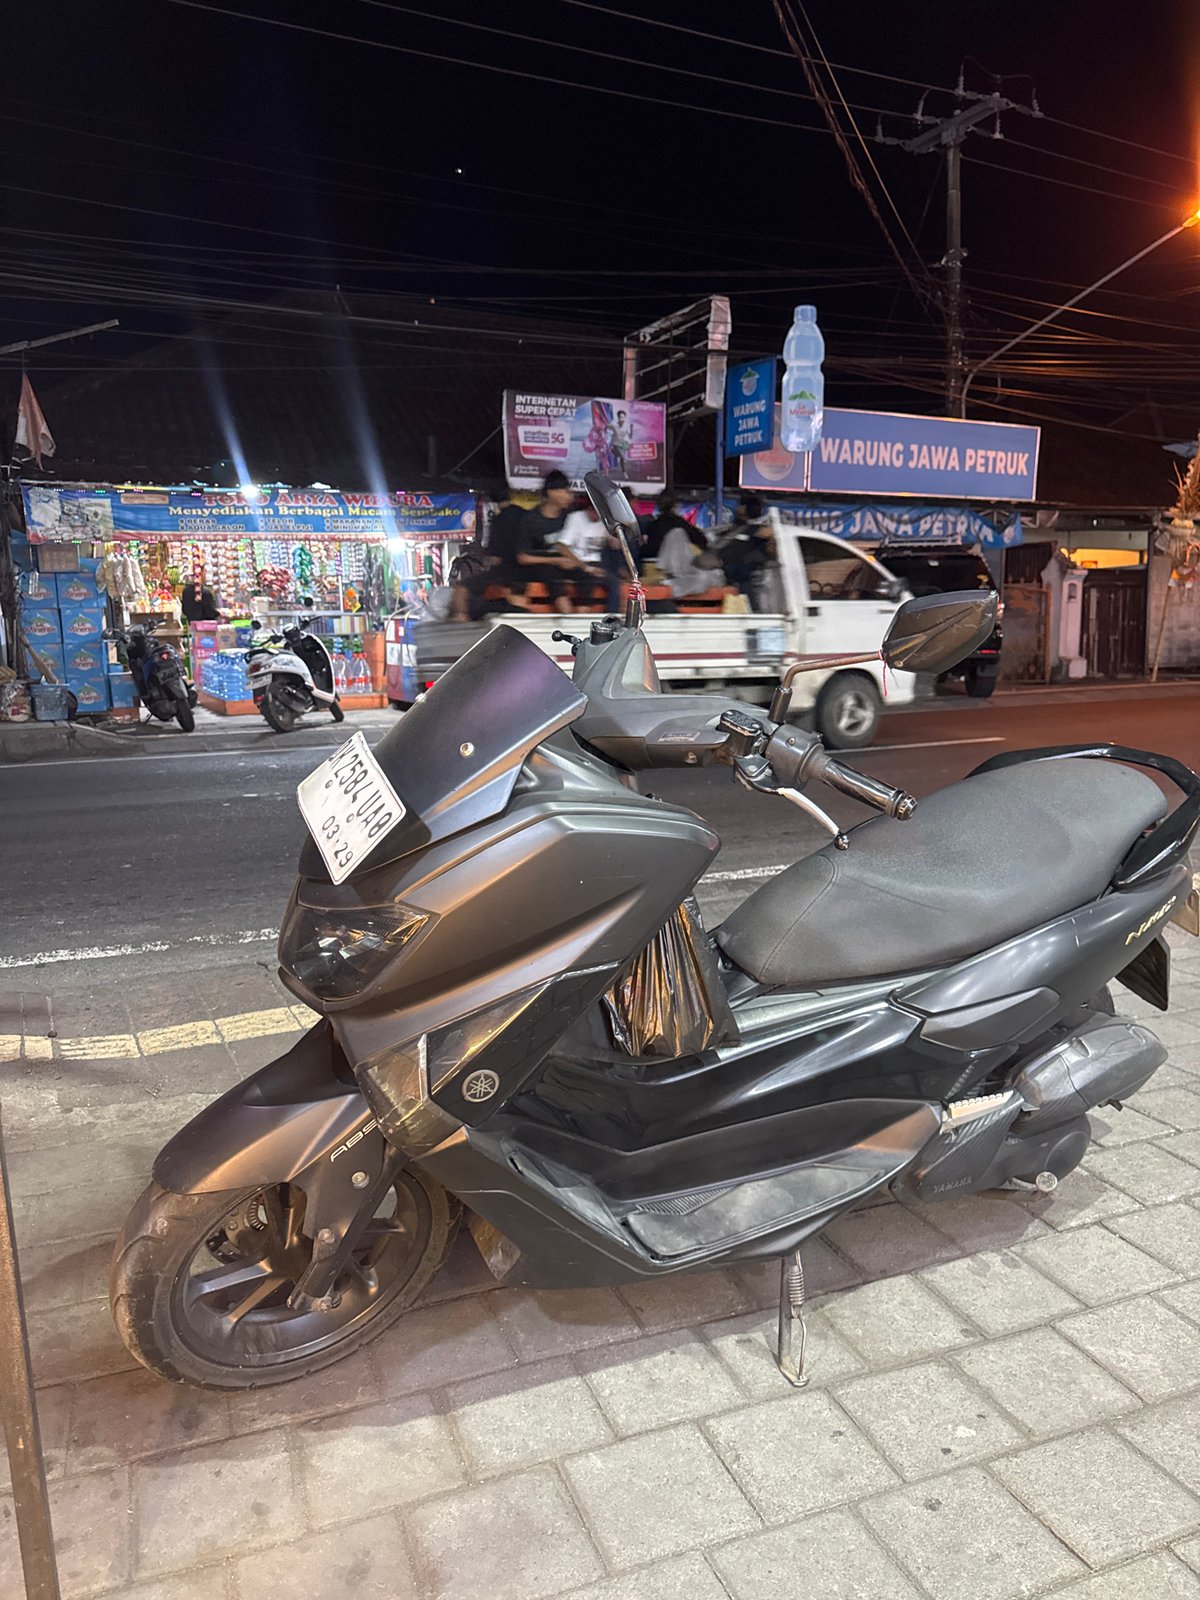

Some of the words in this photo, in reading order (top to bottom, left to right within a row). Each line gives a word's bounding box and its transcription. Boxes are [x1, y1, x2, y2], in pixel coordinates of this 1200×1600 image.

[515, 394, 577, 407] INTERNETAN
[515, 404, 547, 415] SUPER
[547, 407, 577, 417] CEPAT
[733, 400, 766, 417] WARUNG
[738, 417, 760, 431] JAWA
[551, 433, 565, 444] 5G
[734, 430, 763, 447] PETRUK
[820, 437, 903, 468] WARUNG
[908, 444, 959, 471] JAWA
[965, 448, 1029, 476] PETRUK
[274, 493, 338, 507] ARYA
[169, 506, 273, 517] Menyediakan
[278, 506, 343, 518] Berbagai
[849, 510, 913, 536] JAWA
[330, 1118, 378, 1163] ABS
[933, 1176, 974, 1194] YAMAHA
